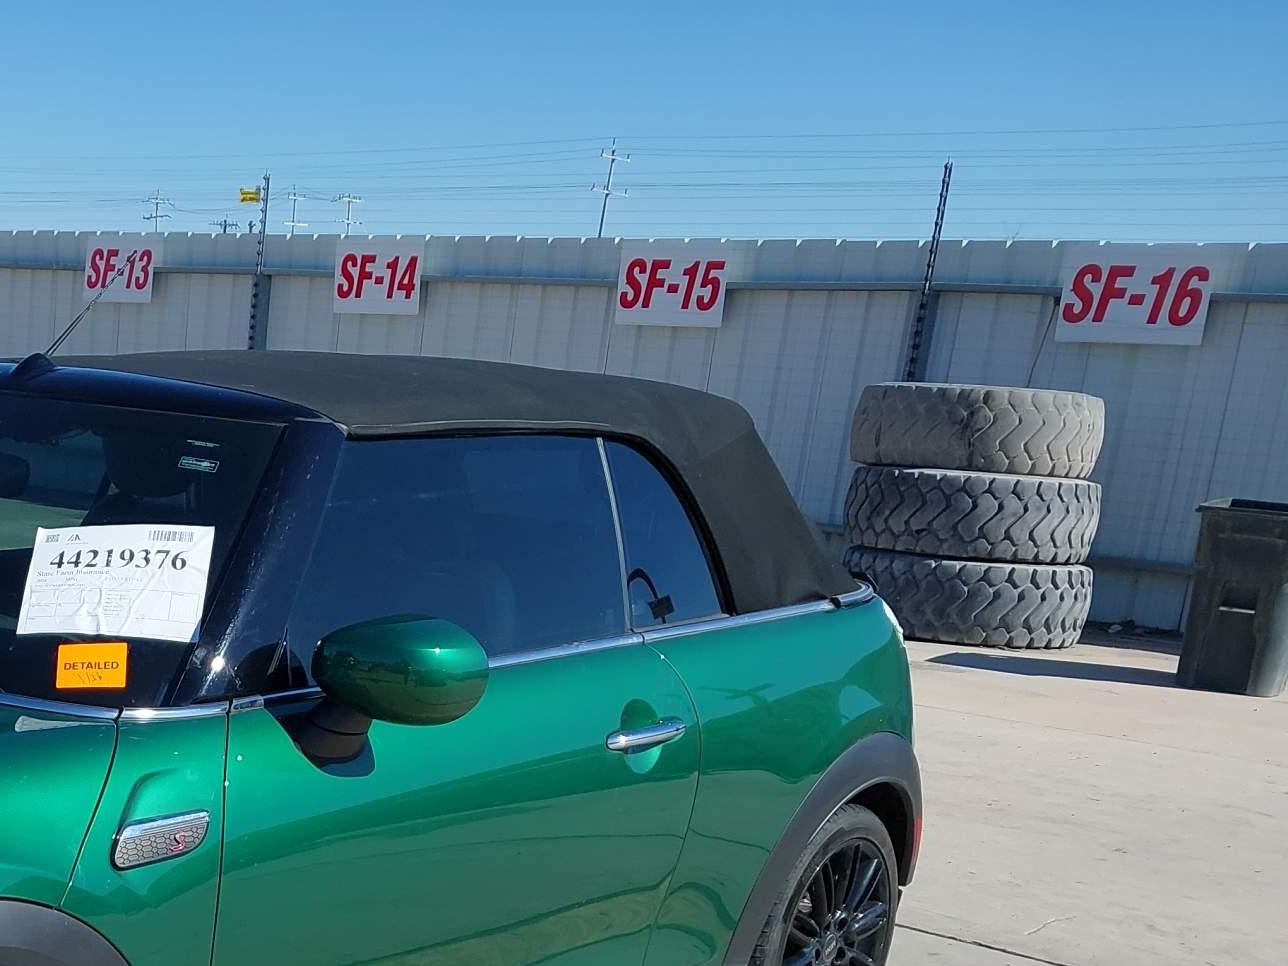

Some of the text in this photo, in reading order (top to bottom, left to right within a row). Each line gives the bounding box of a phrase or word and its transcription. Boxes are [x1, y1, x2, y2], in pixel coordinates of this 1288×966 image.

[86, 248, 153, 290] SF-13
[336, 252, 419, 300] SF-14
[619, 258, 726, 312] SF-15
[1062, 264, 1210, 327] SF-16
[49, 548, 188, 570] 44219376
[63, 661, 119, 671] DETAILED
[168, 831, 186, 852] S
